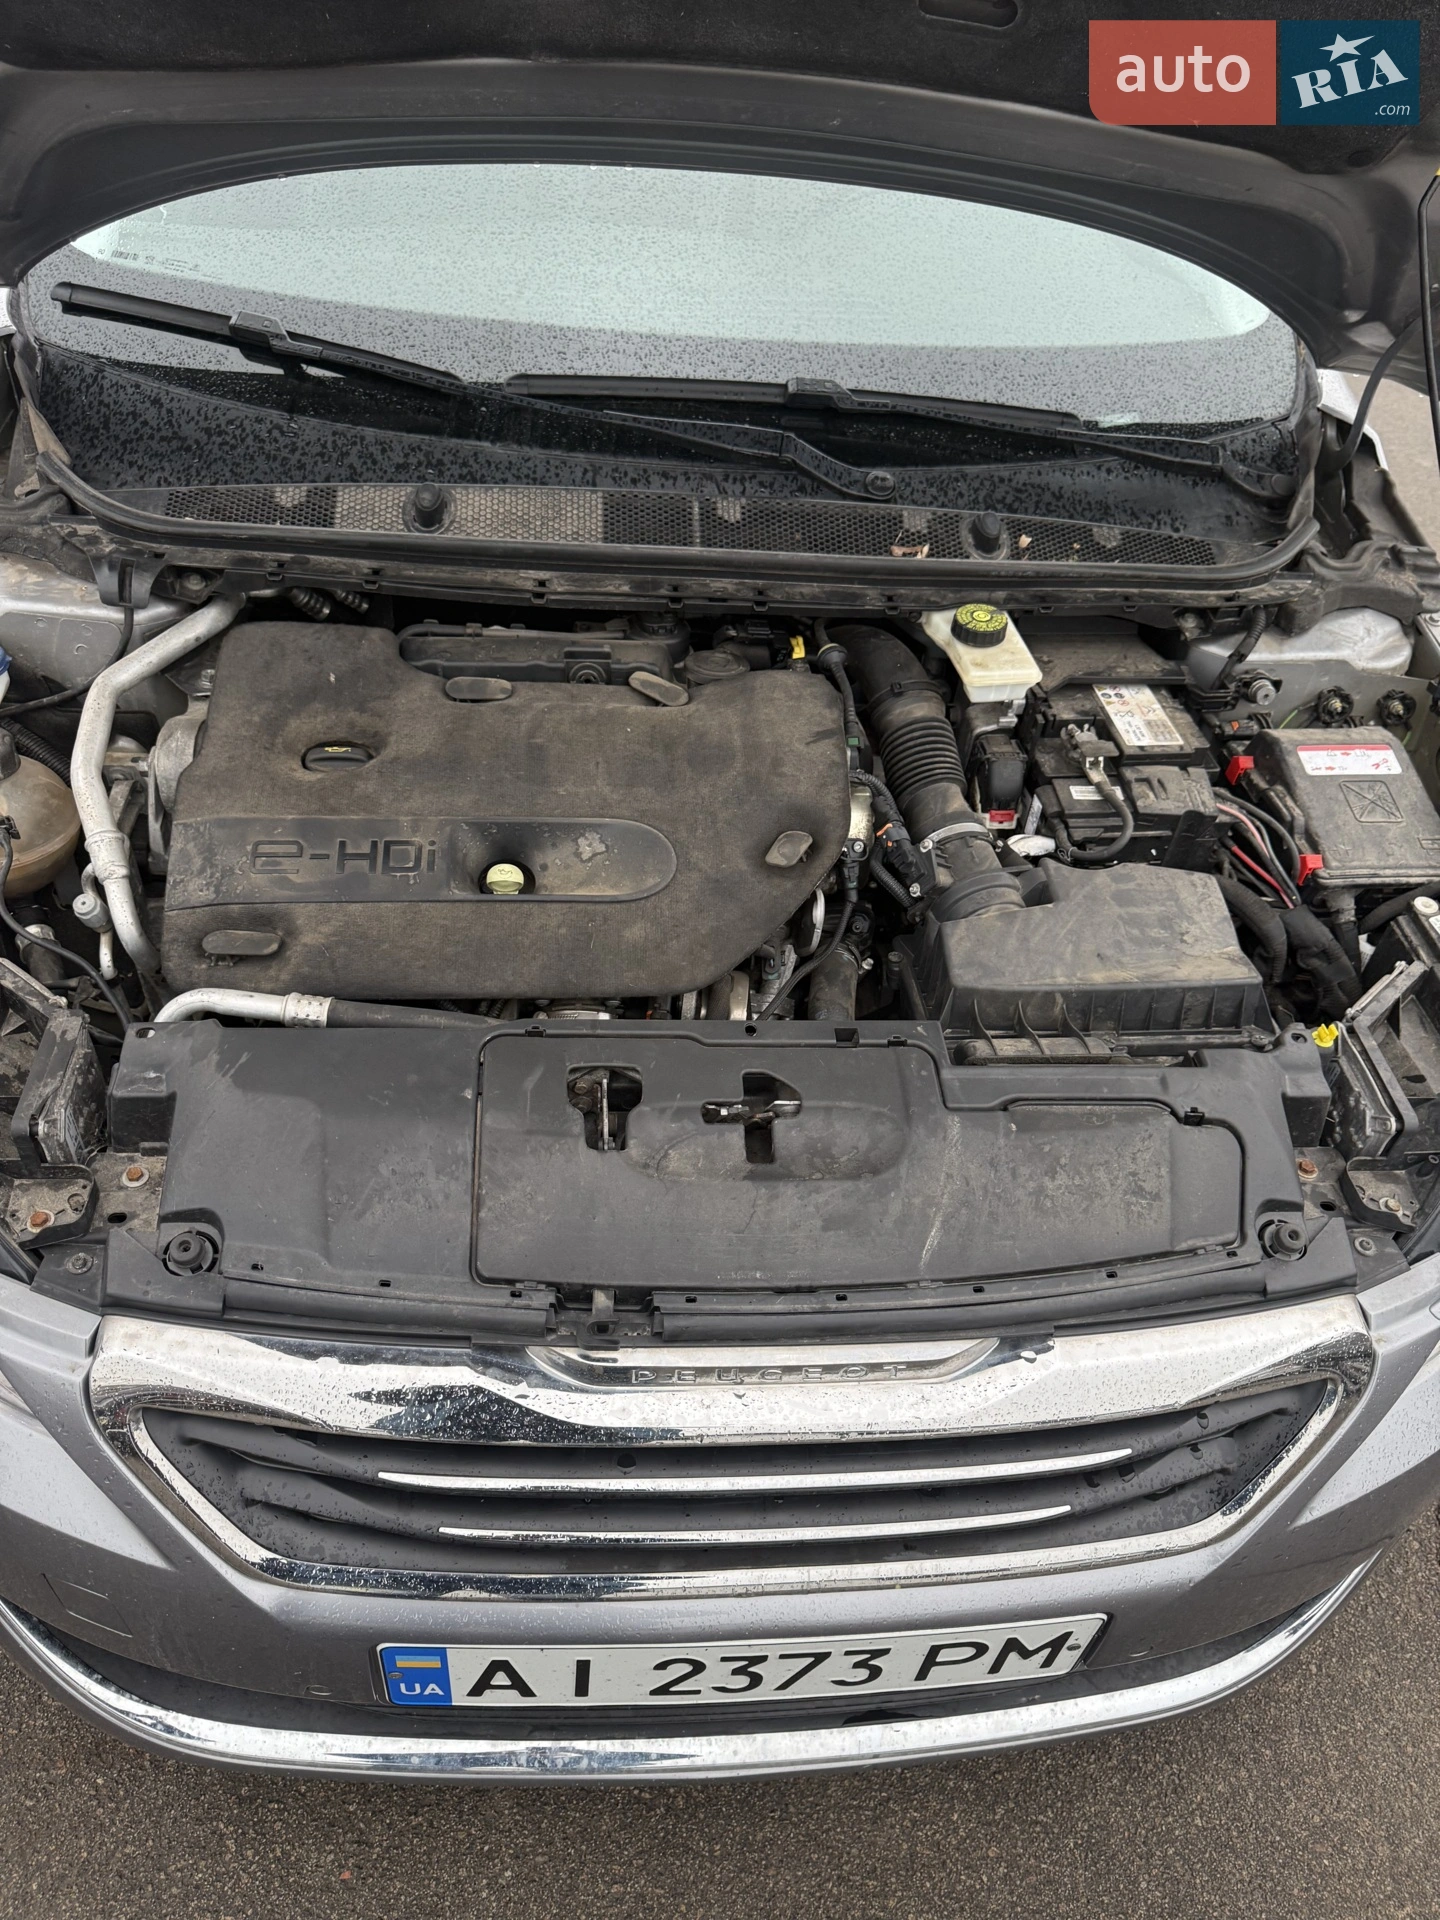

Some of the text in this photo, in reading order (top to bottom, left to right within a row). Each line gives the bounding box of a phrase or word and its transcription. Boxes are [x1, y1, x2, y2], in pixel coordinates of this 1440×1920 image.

[250, 838, 437, 875] e-HDi
[631, 1364, 907, 1384] PEUGEOT
[465, 1630, 1075, 1698] AI 2373 PM
[399, 1682, 446, 1697] UA
